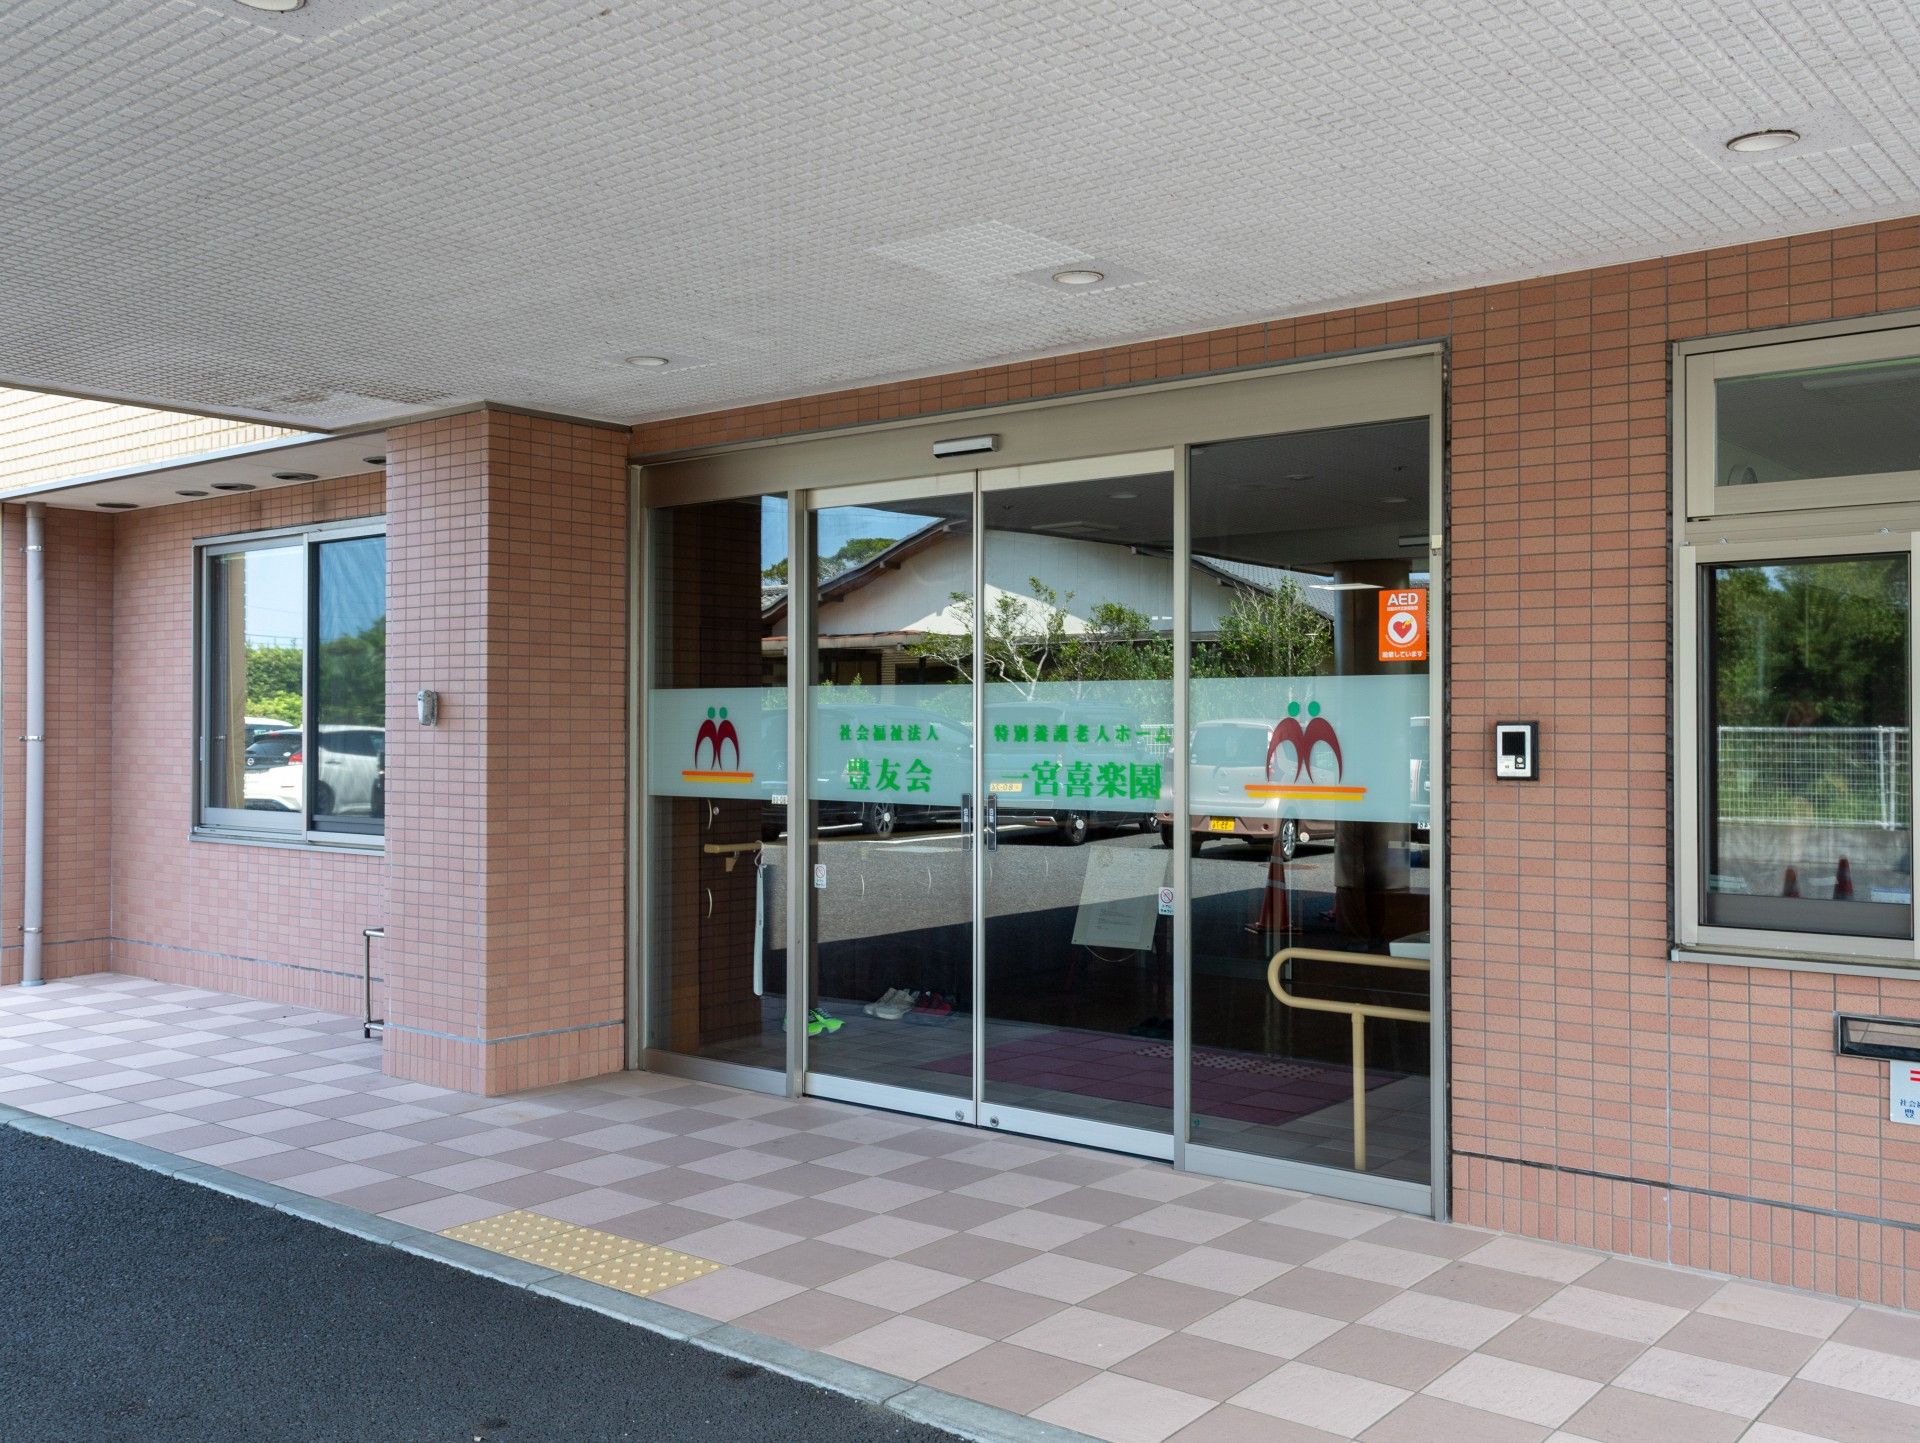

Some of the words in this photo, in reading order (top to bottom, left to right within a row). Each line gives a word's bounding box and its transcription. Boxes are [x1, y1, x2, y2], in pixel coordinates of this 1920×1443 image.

[1387, 592, 1419, 605] AED
[839, 724, 939, 742] 社会福祉法人
[993, 724, 1172, 743] 特別養護老人ホーム
[1000, 760, 1163, 800] 一宮喜楽園
